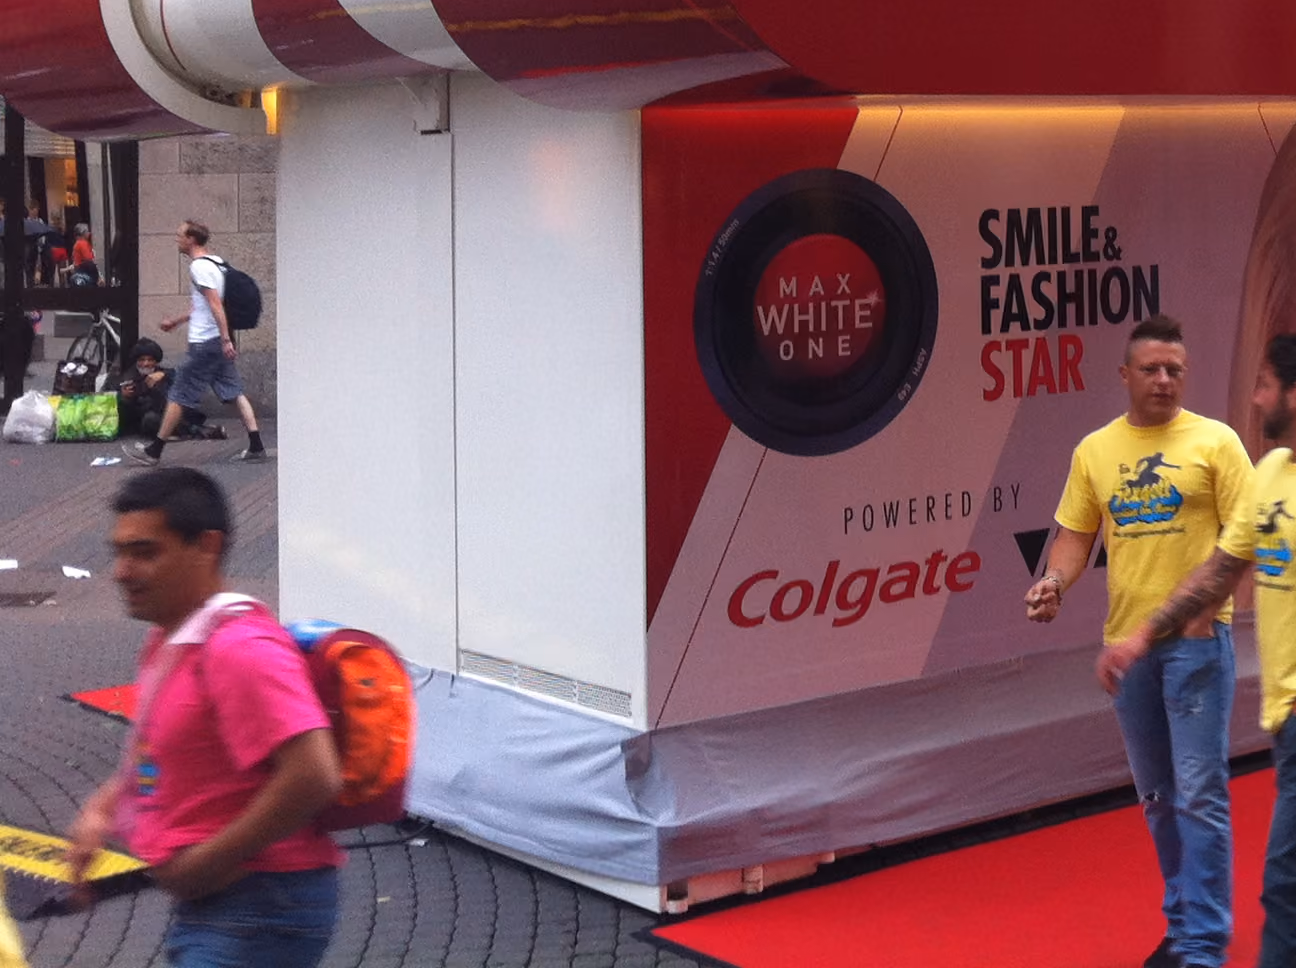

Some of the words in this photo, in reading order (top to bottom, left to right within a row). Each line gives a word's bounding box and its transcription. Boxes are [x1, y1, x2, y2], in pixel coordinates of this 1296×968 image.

[779, 273, 851, 299] MAX
[980, 263, 1160, 335] FASHION
[756, 298, 873, 337] WHITE
[779, 334, 851, 362] ONE
[979, 333, 1084, 402] STAR
[843, 489, 972, 535] POWERED
[993, 482, 1023, 513] BY
[726, 548, 982, 629] Colgate
